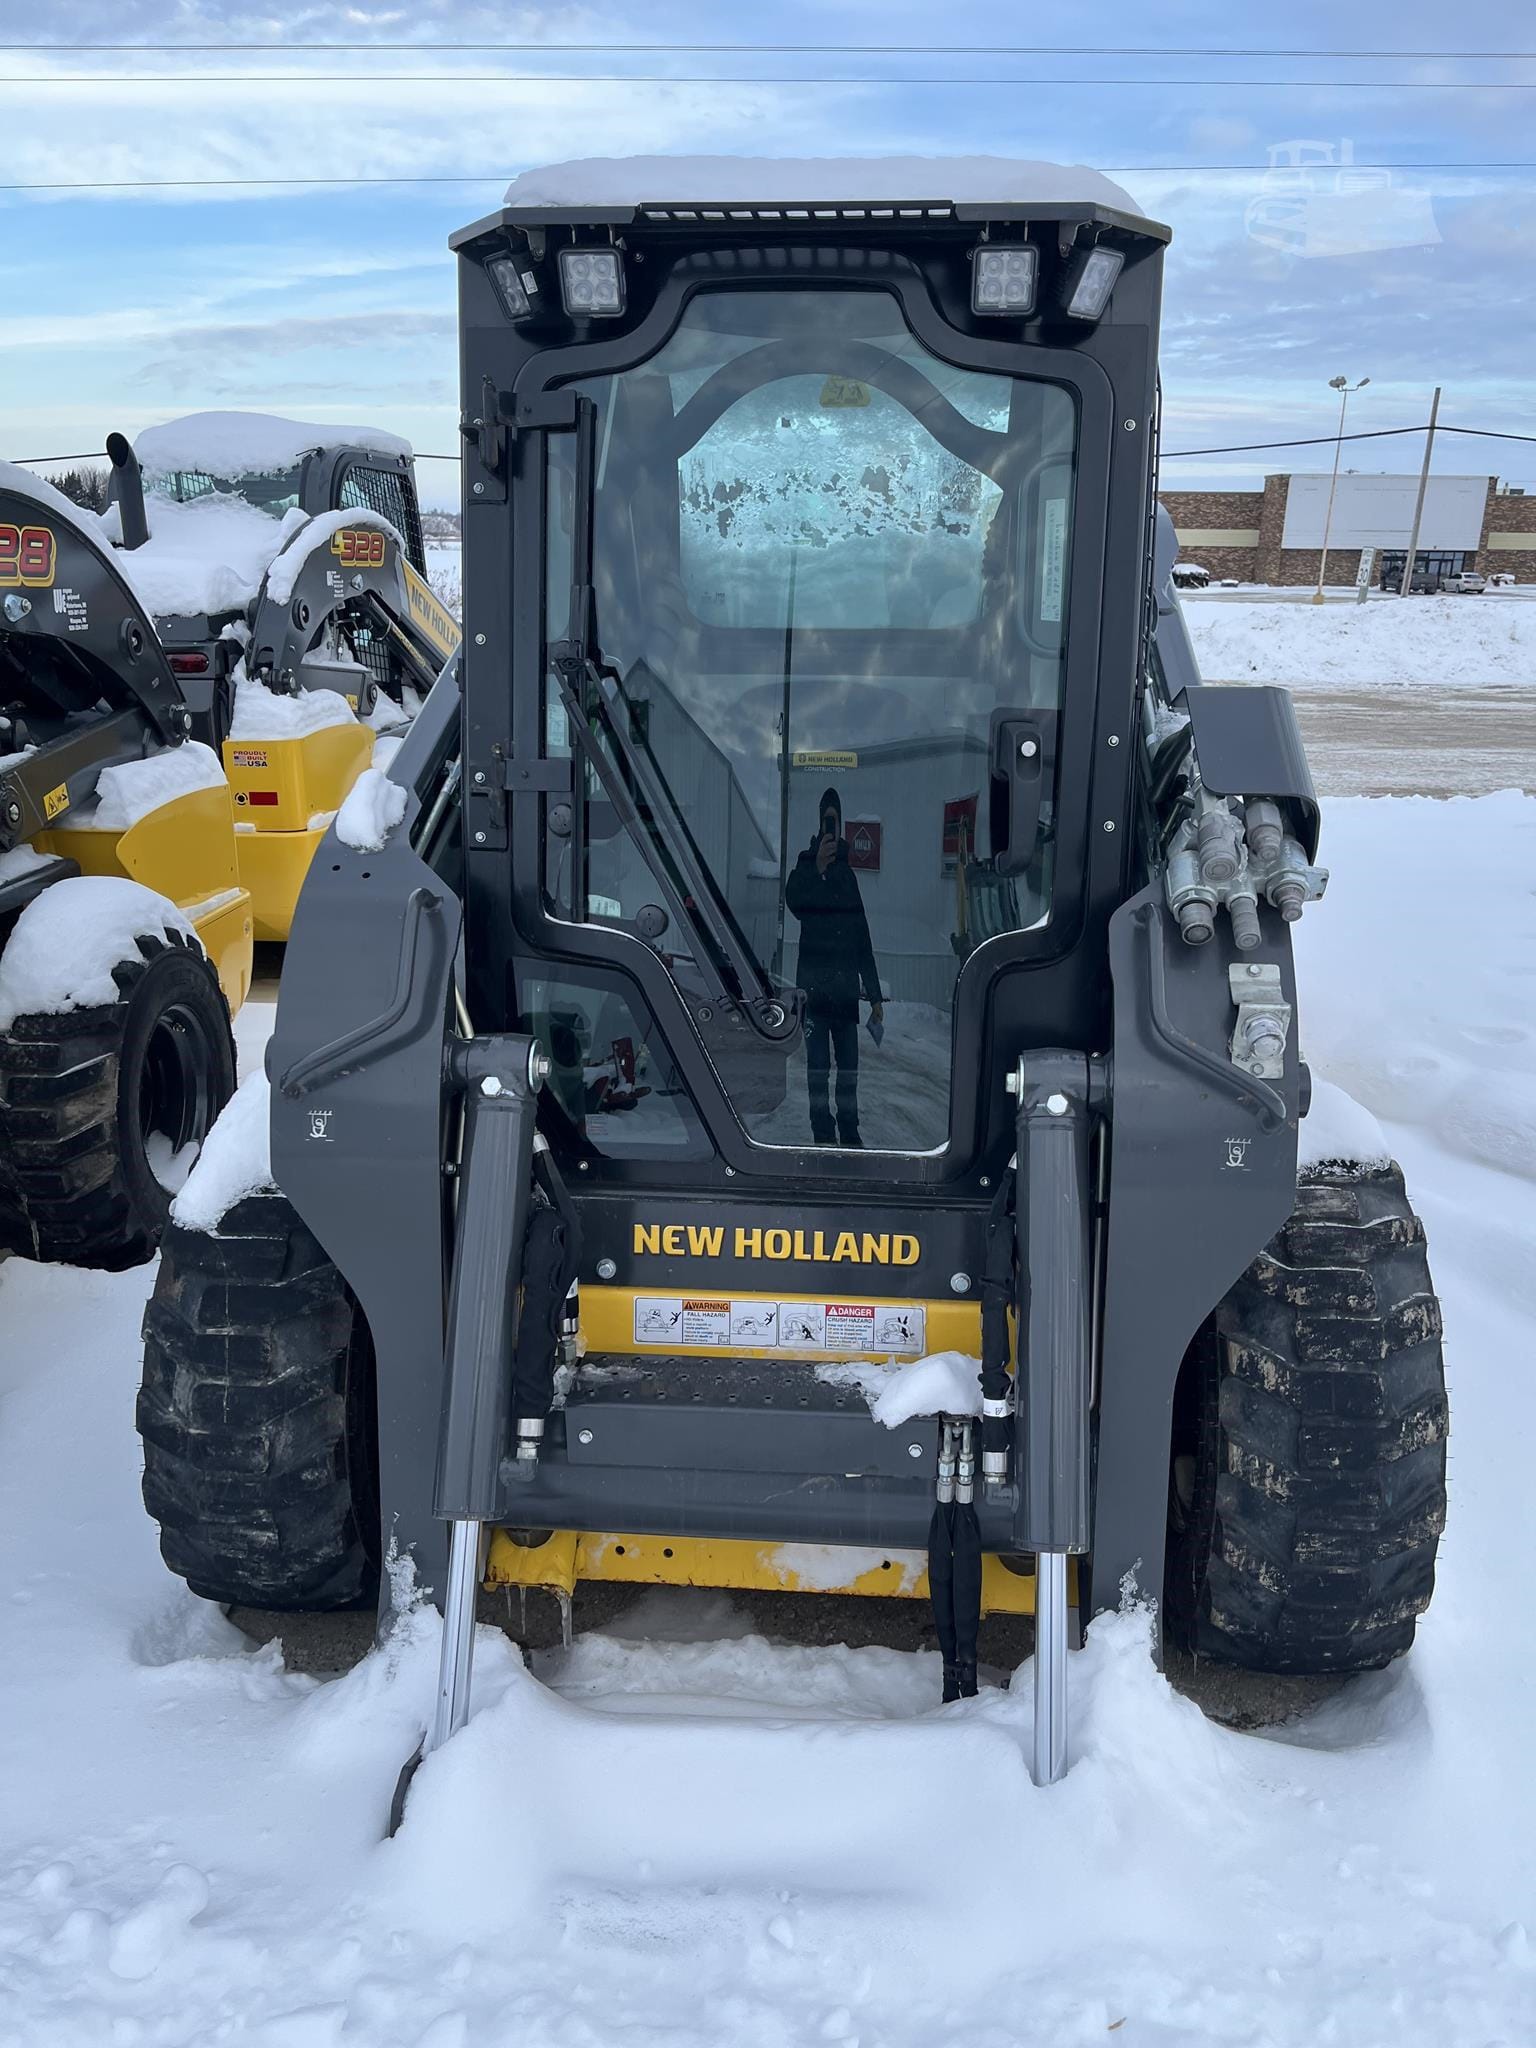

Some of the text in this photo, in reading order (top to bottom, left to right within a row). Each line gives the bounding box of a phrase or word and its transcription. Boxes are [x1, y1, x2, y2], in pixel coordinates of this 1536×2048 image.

[331, 530, 384, 567] L328
[1357, 567, 1369, 583] 30
[411, 585, 432, 621] NEW
[633, 1223, 921, 1266] NEW HOLLAND
[692, 1302, 729, 1311] WARNING
[838, 1307, 872, 1317] DANGER
